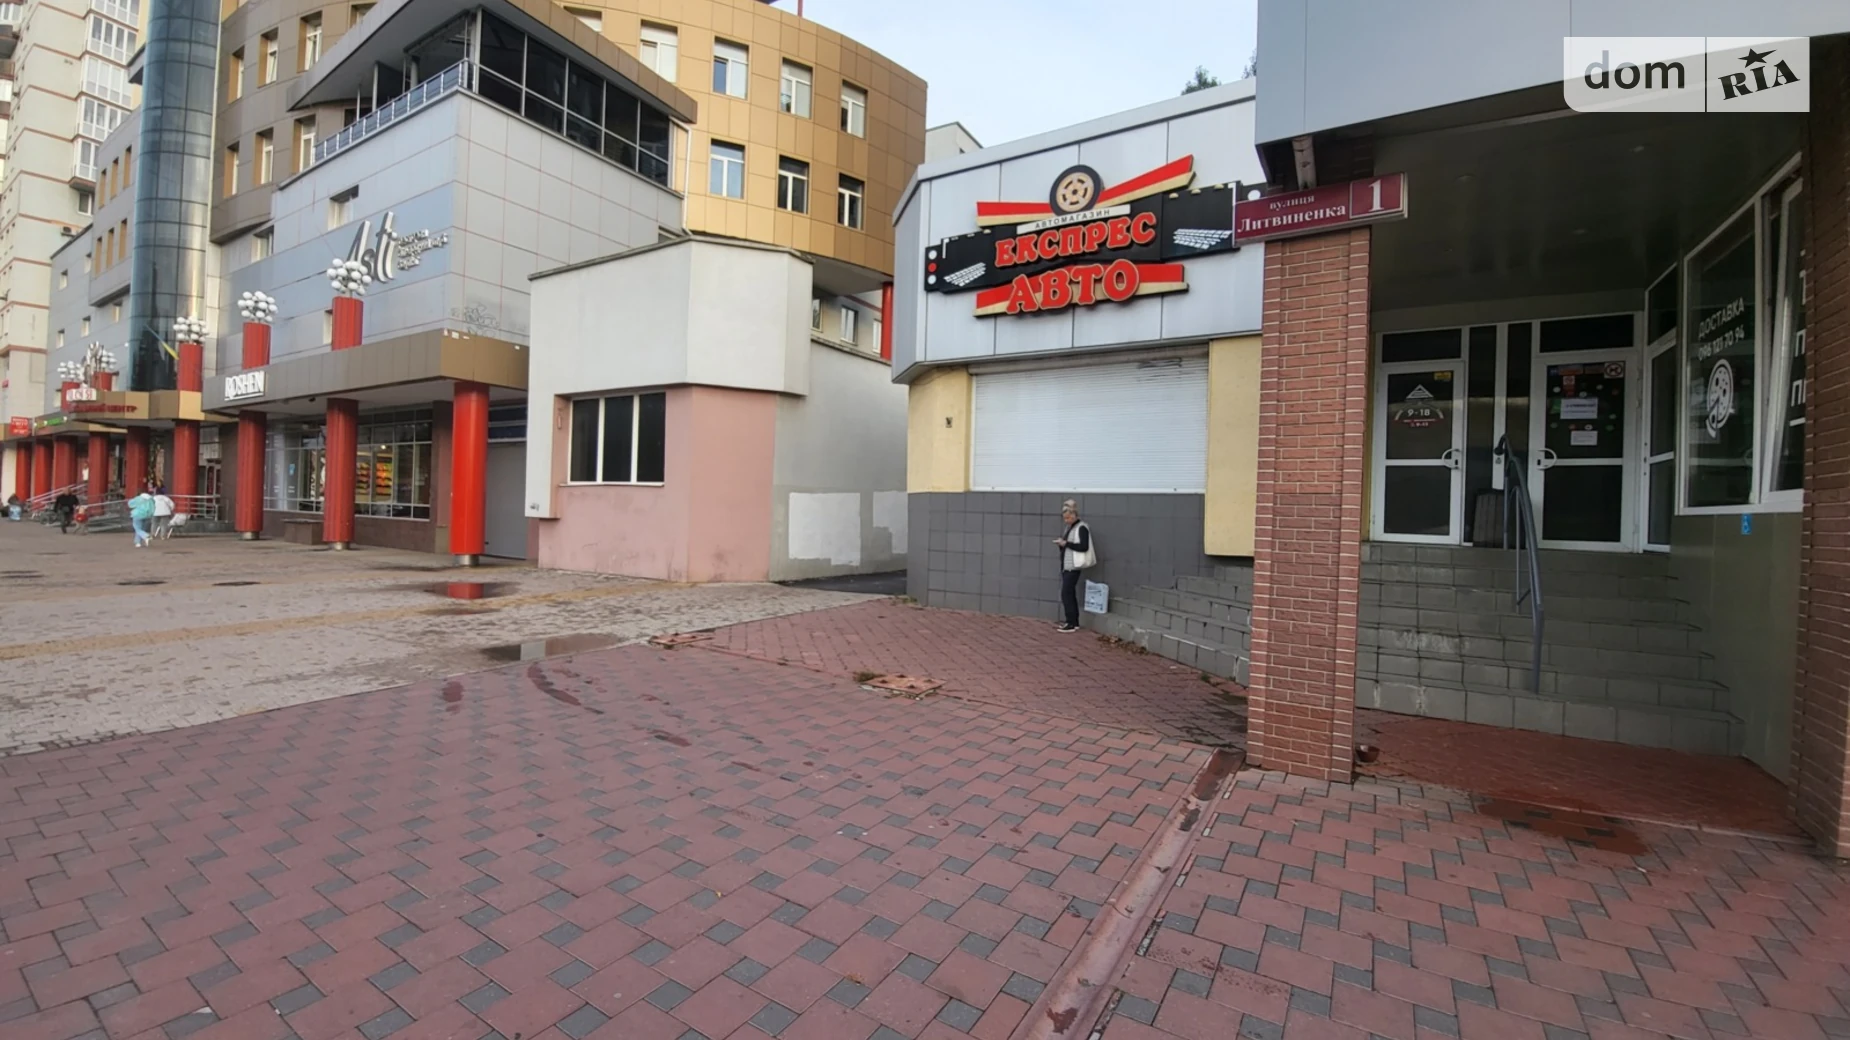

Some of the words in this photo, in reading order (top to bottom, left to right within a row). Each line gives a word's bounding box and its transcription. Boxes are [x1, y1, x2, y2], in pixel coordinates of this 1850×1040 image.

[1269, 194, 1315, 211] вулиця
[1368, 179, 1384, 212] 1
[1035, 209, 1110, 229] АВТОМАГАЗИН
[1237, 205, 1346, 232] Литвиненка
[995, 212, 1157, 267] ЕКСПРЕС
[1006, 258, 1140, 314] АВТО
[1699, 296, 1744, 340] ДОСТАВКА
[224, 370, 265, 399] ROSHEN
